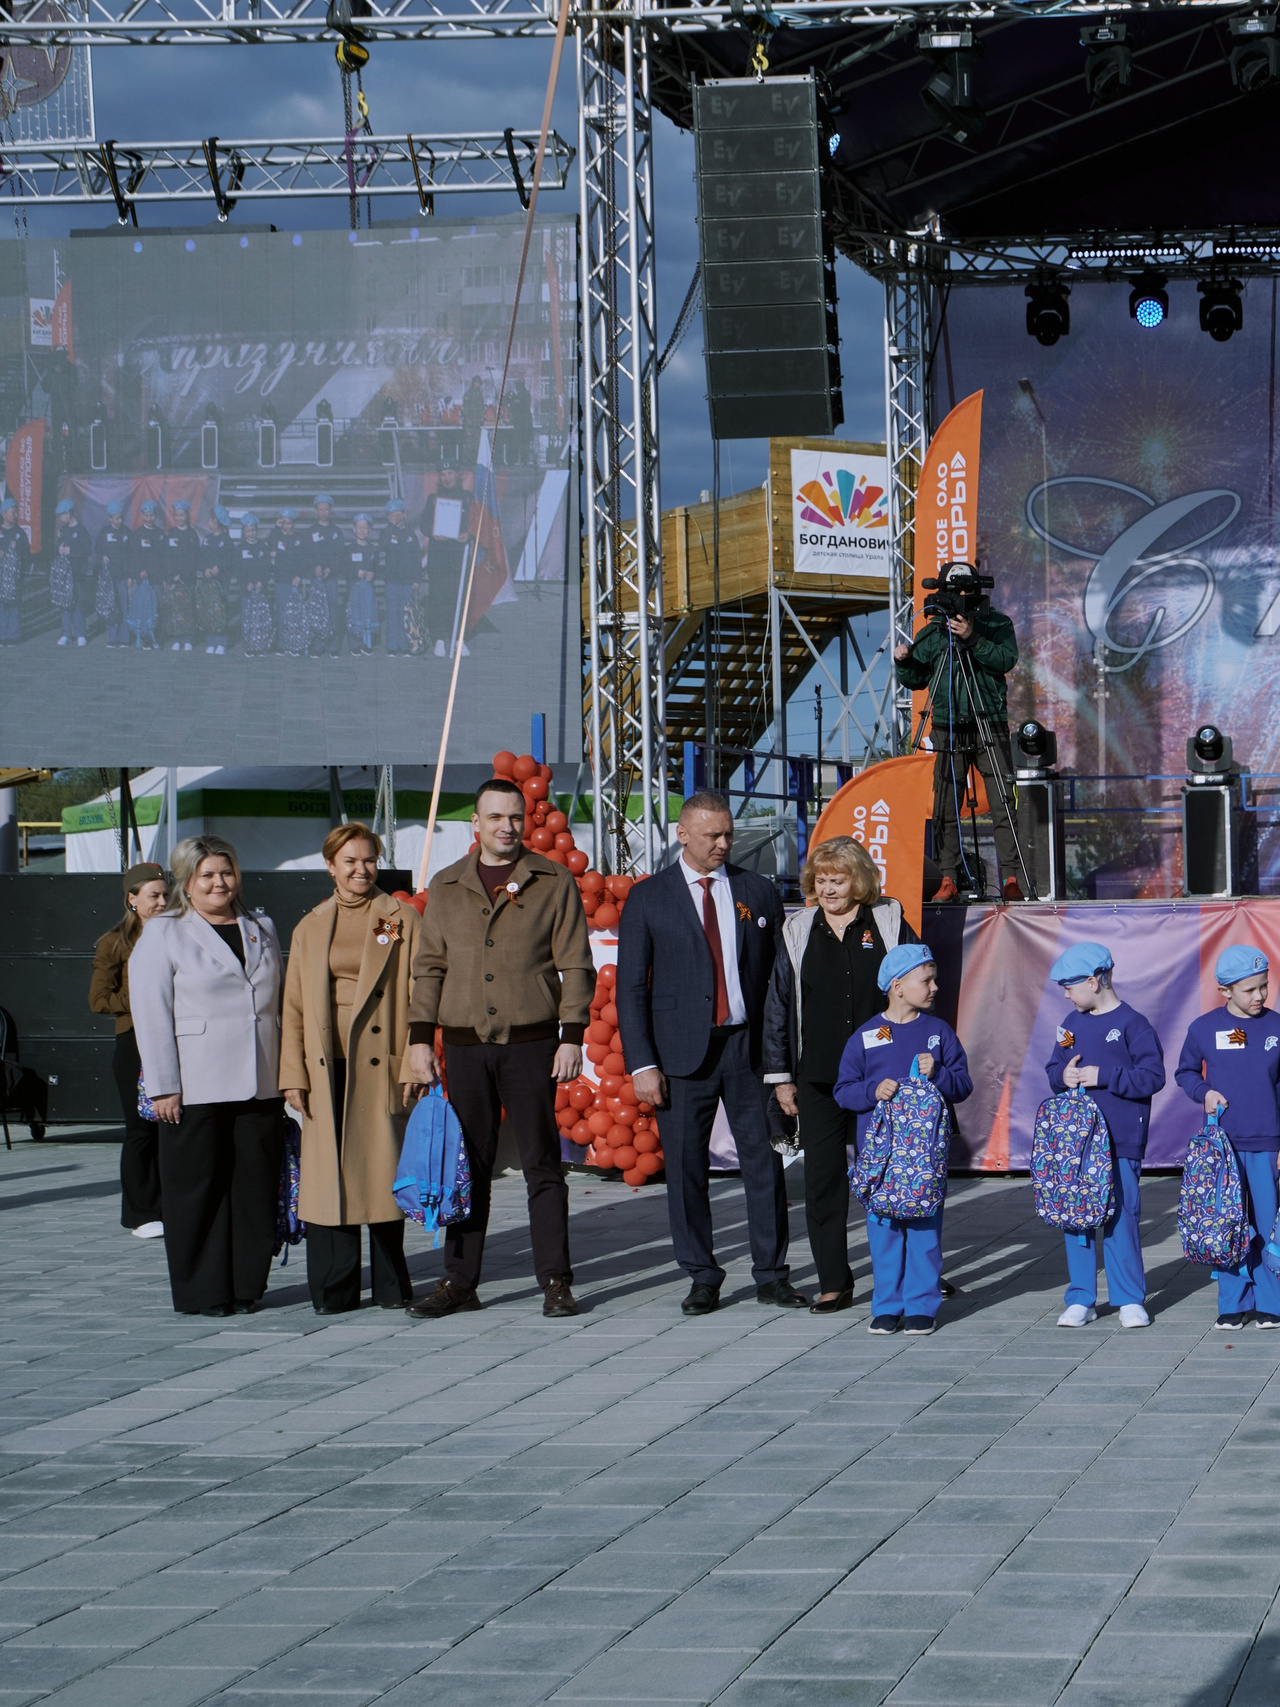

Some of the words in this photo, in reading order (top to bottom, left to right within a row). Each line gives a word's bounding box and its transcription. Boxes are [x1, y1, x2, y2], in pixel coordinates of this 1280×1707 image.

[936, 462, 948, 507] ОАО
[838, 552, 864, 560] столица
[865, 553, 884, 561] Урала
[1025, 475, 1242, 673] С
[852, 805, 867, 844] ОАО
